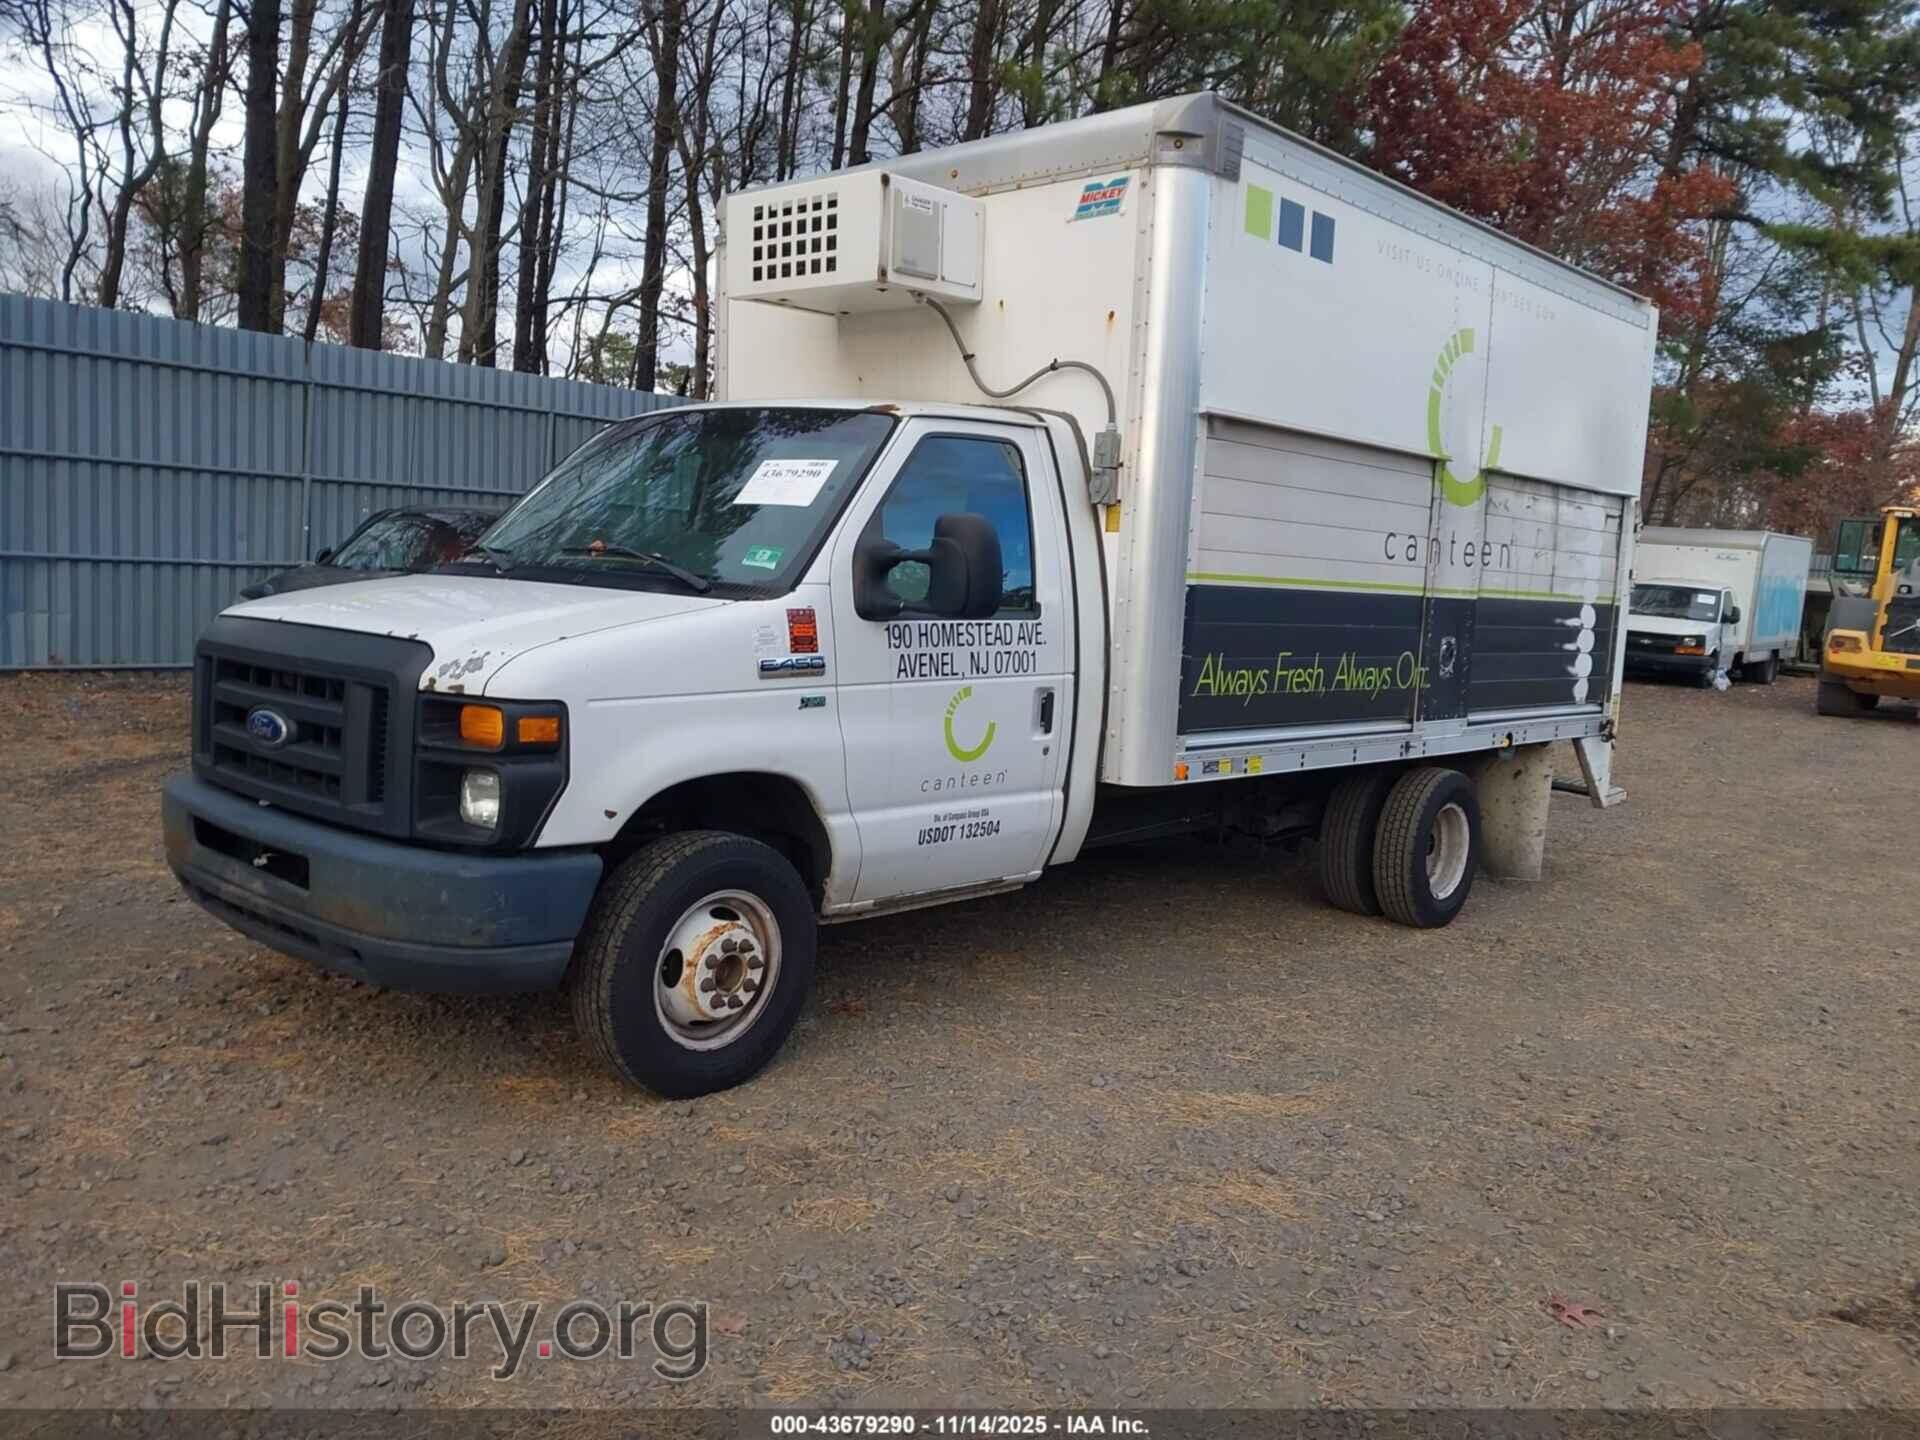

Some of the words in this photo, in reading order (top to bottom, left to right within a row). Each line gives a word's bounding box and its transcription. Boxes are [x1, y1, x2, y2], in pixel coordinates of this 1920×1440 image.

[1384, 531, 1511, 569] canteen
[885, 623, 912, 649] 190
[918, 622, 1013, 648] HOMESTEAD
[1017, 622, 1047, 646] AVE.
[897, 652, 966, 680] AVENEL,
[970, 651, 990, 675] NJ
[994, 650, 1037, 673] 07001
[1191, 652, 1269, 707] Always
[1273, 652, 1326, 696] Fresh,
[1331, 652, 1392, 701] Always
[920, 770, 1006, 792] canteen
[918, 825, 956, 846] USDOT
[959, 819, 1000, 840] 132504
